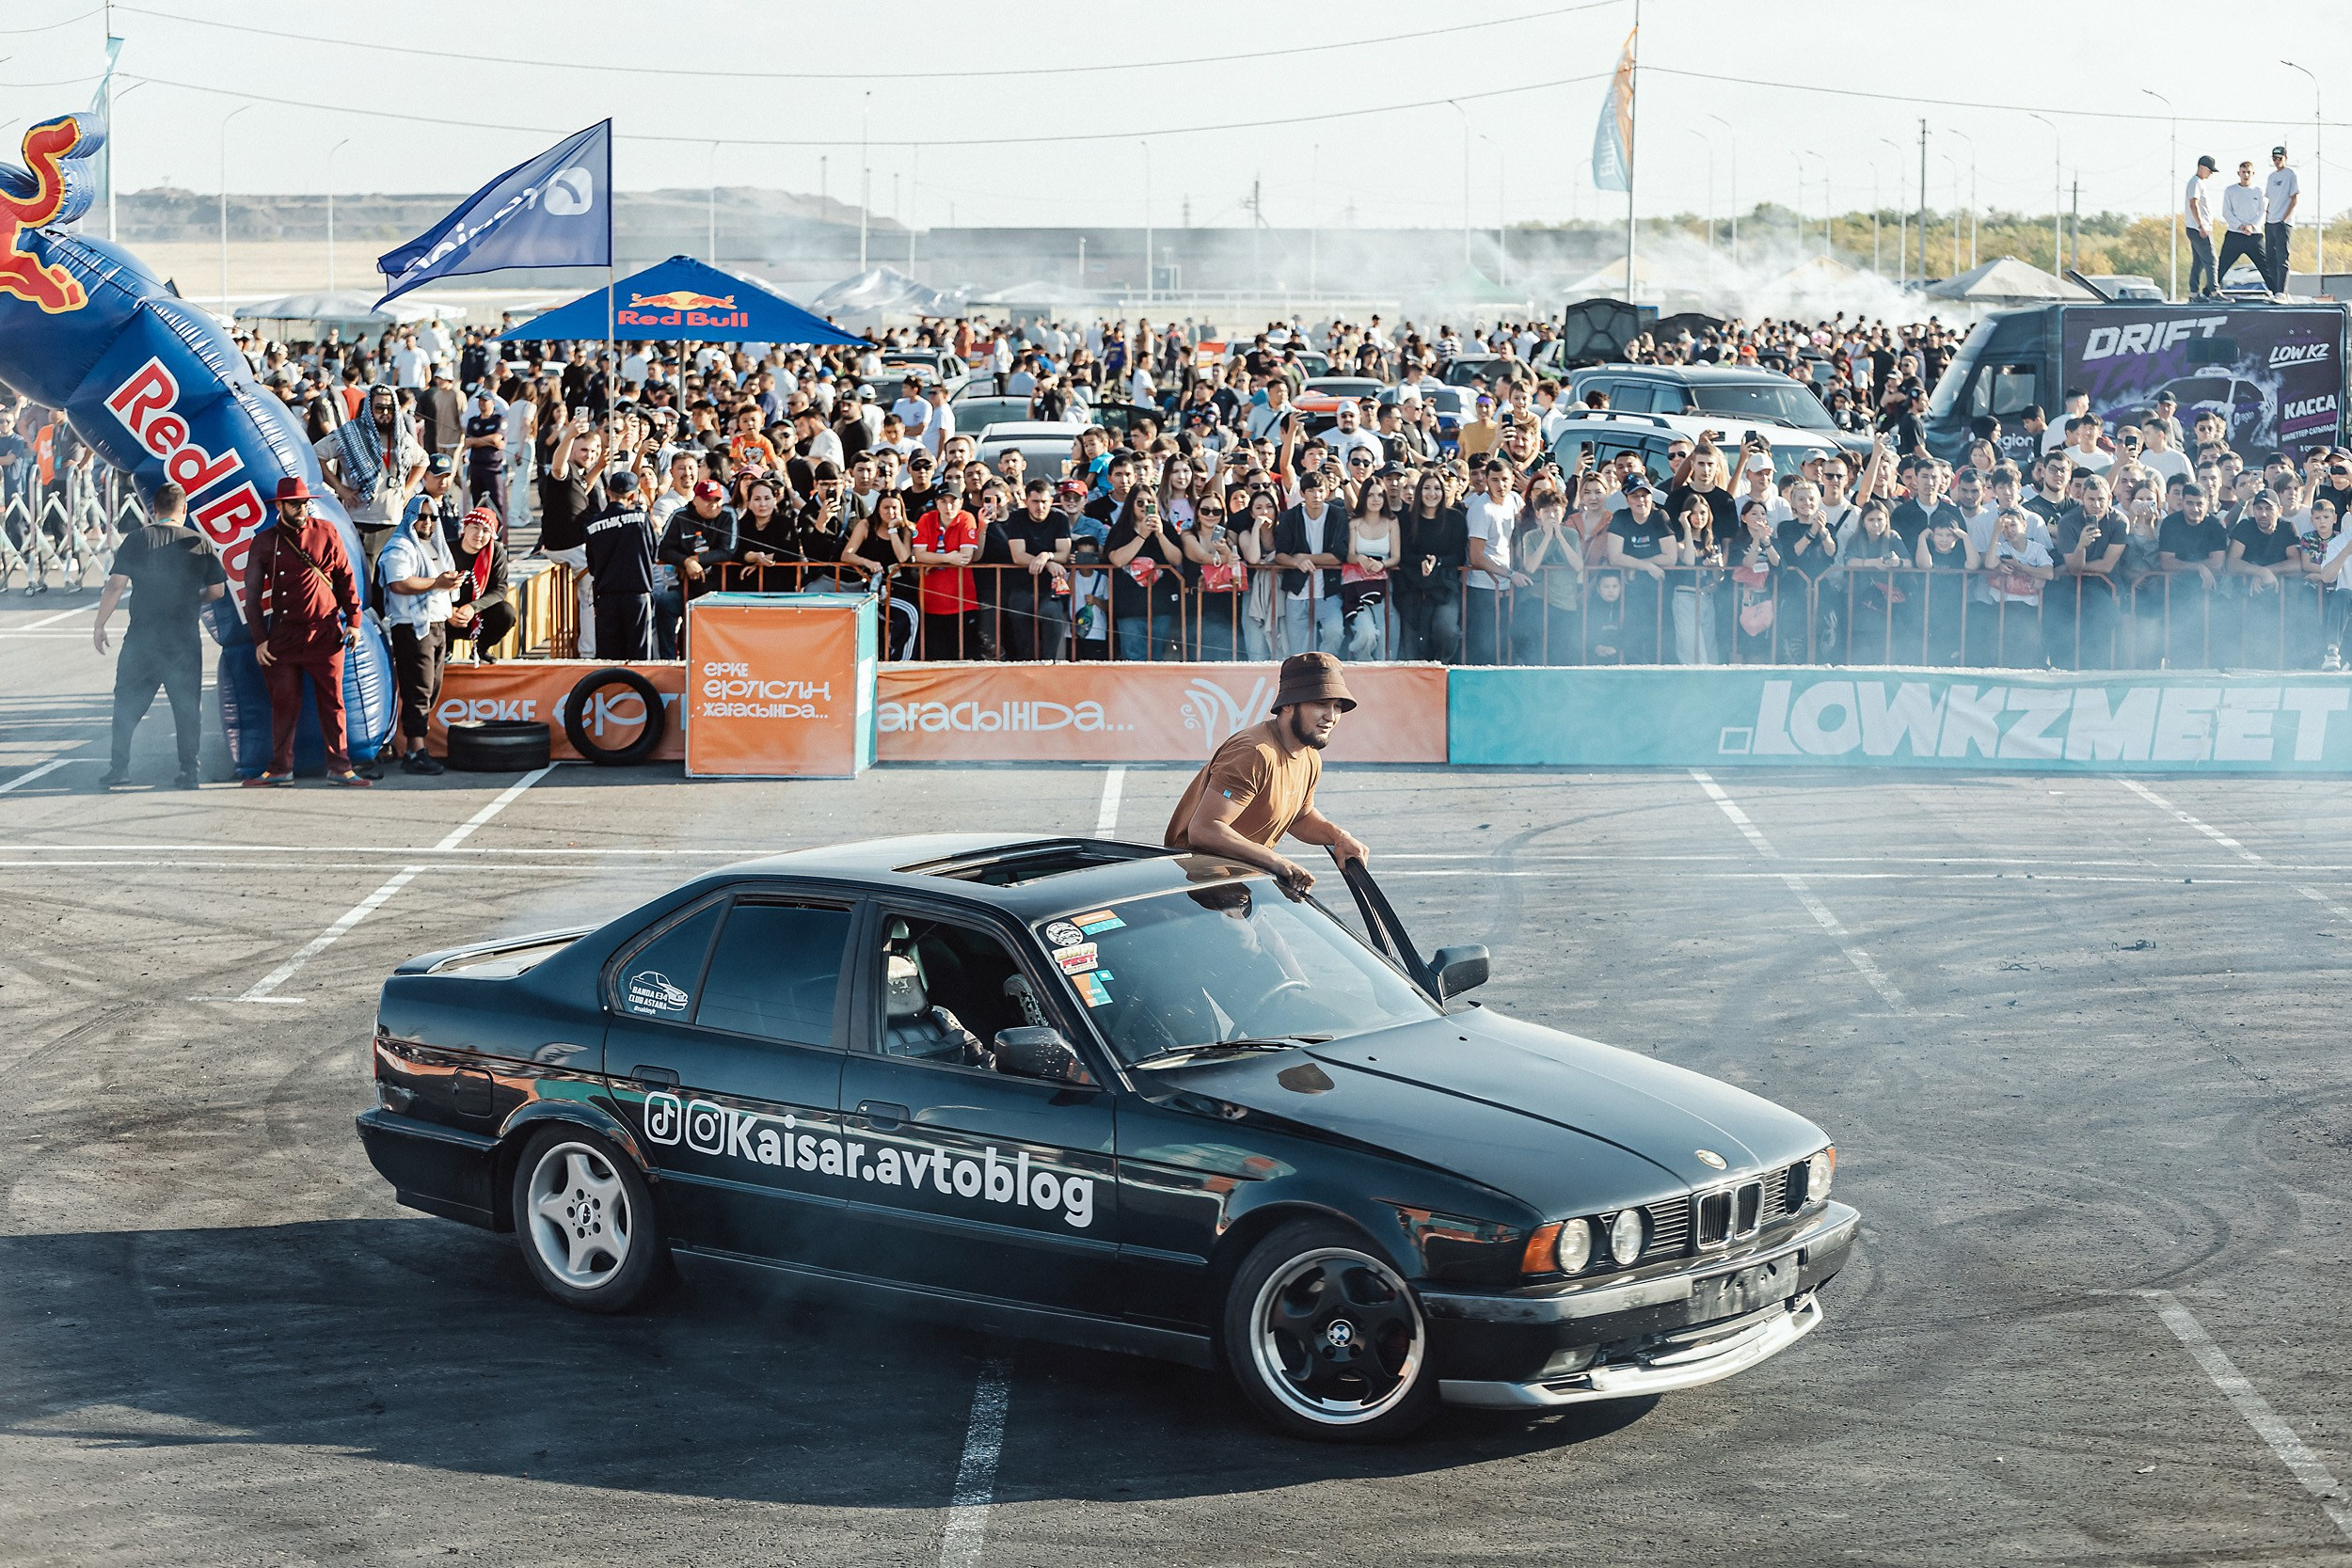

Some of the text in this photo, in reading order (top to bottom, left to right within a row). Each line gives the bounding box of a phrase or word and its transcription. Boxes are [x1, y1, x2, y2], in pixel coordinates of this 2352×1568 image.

[618, 310, 748, 327] Red Bull
[2082, 316, 2228, 361] DRIFT
[2268, 342, 2330, 363] LOW KZ
[2283, 394, 2337, 420] КАССА
[104, 357, 244, 500] Red
[628, 993, 644, 1005] CLUB
[644, 997, 667, 1010] ASTANA
[727, 1111, 1094, 1227] Kaisar.avtoblog
